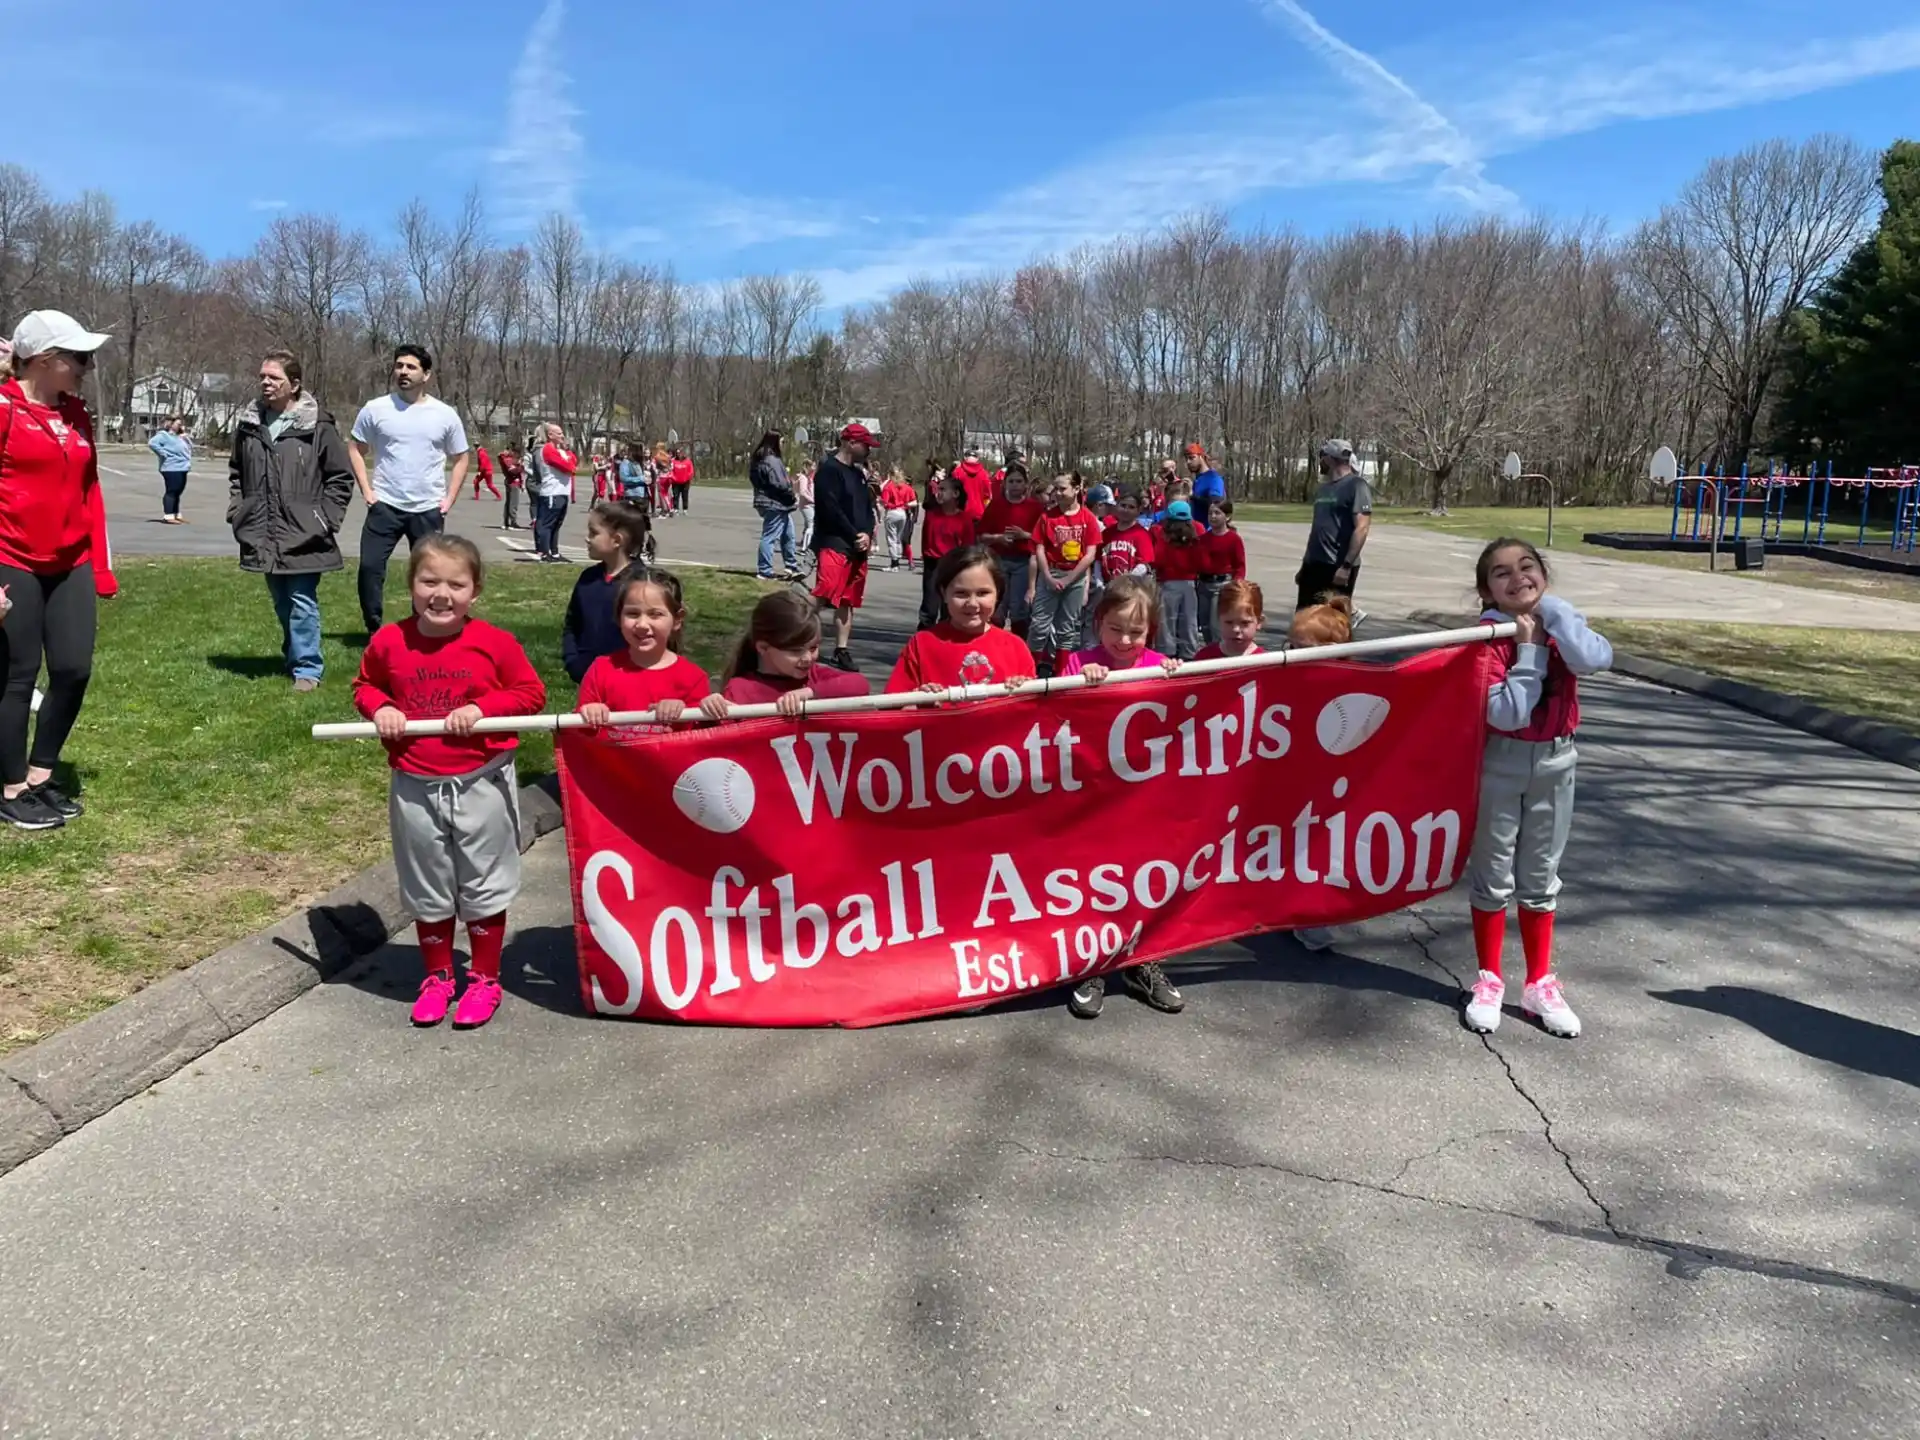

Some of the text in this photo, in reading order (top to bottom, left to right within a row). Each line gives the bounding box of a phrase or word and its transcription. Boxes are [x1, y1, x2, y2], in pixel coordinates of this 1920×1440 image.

[770, 680, 1292, 825] Wolcott Girls
[581, 776, 1461, 1015] Softball Association
[950, 939, 1040, 998] Est.
